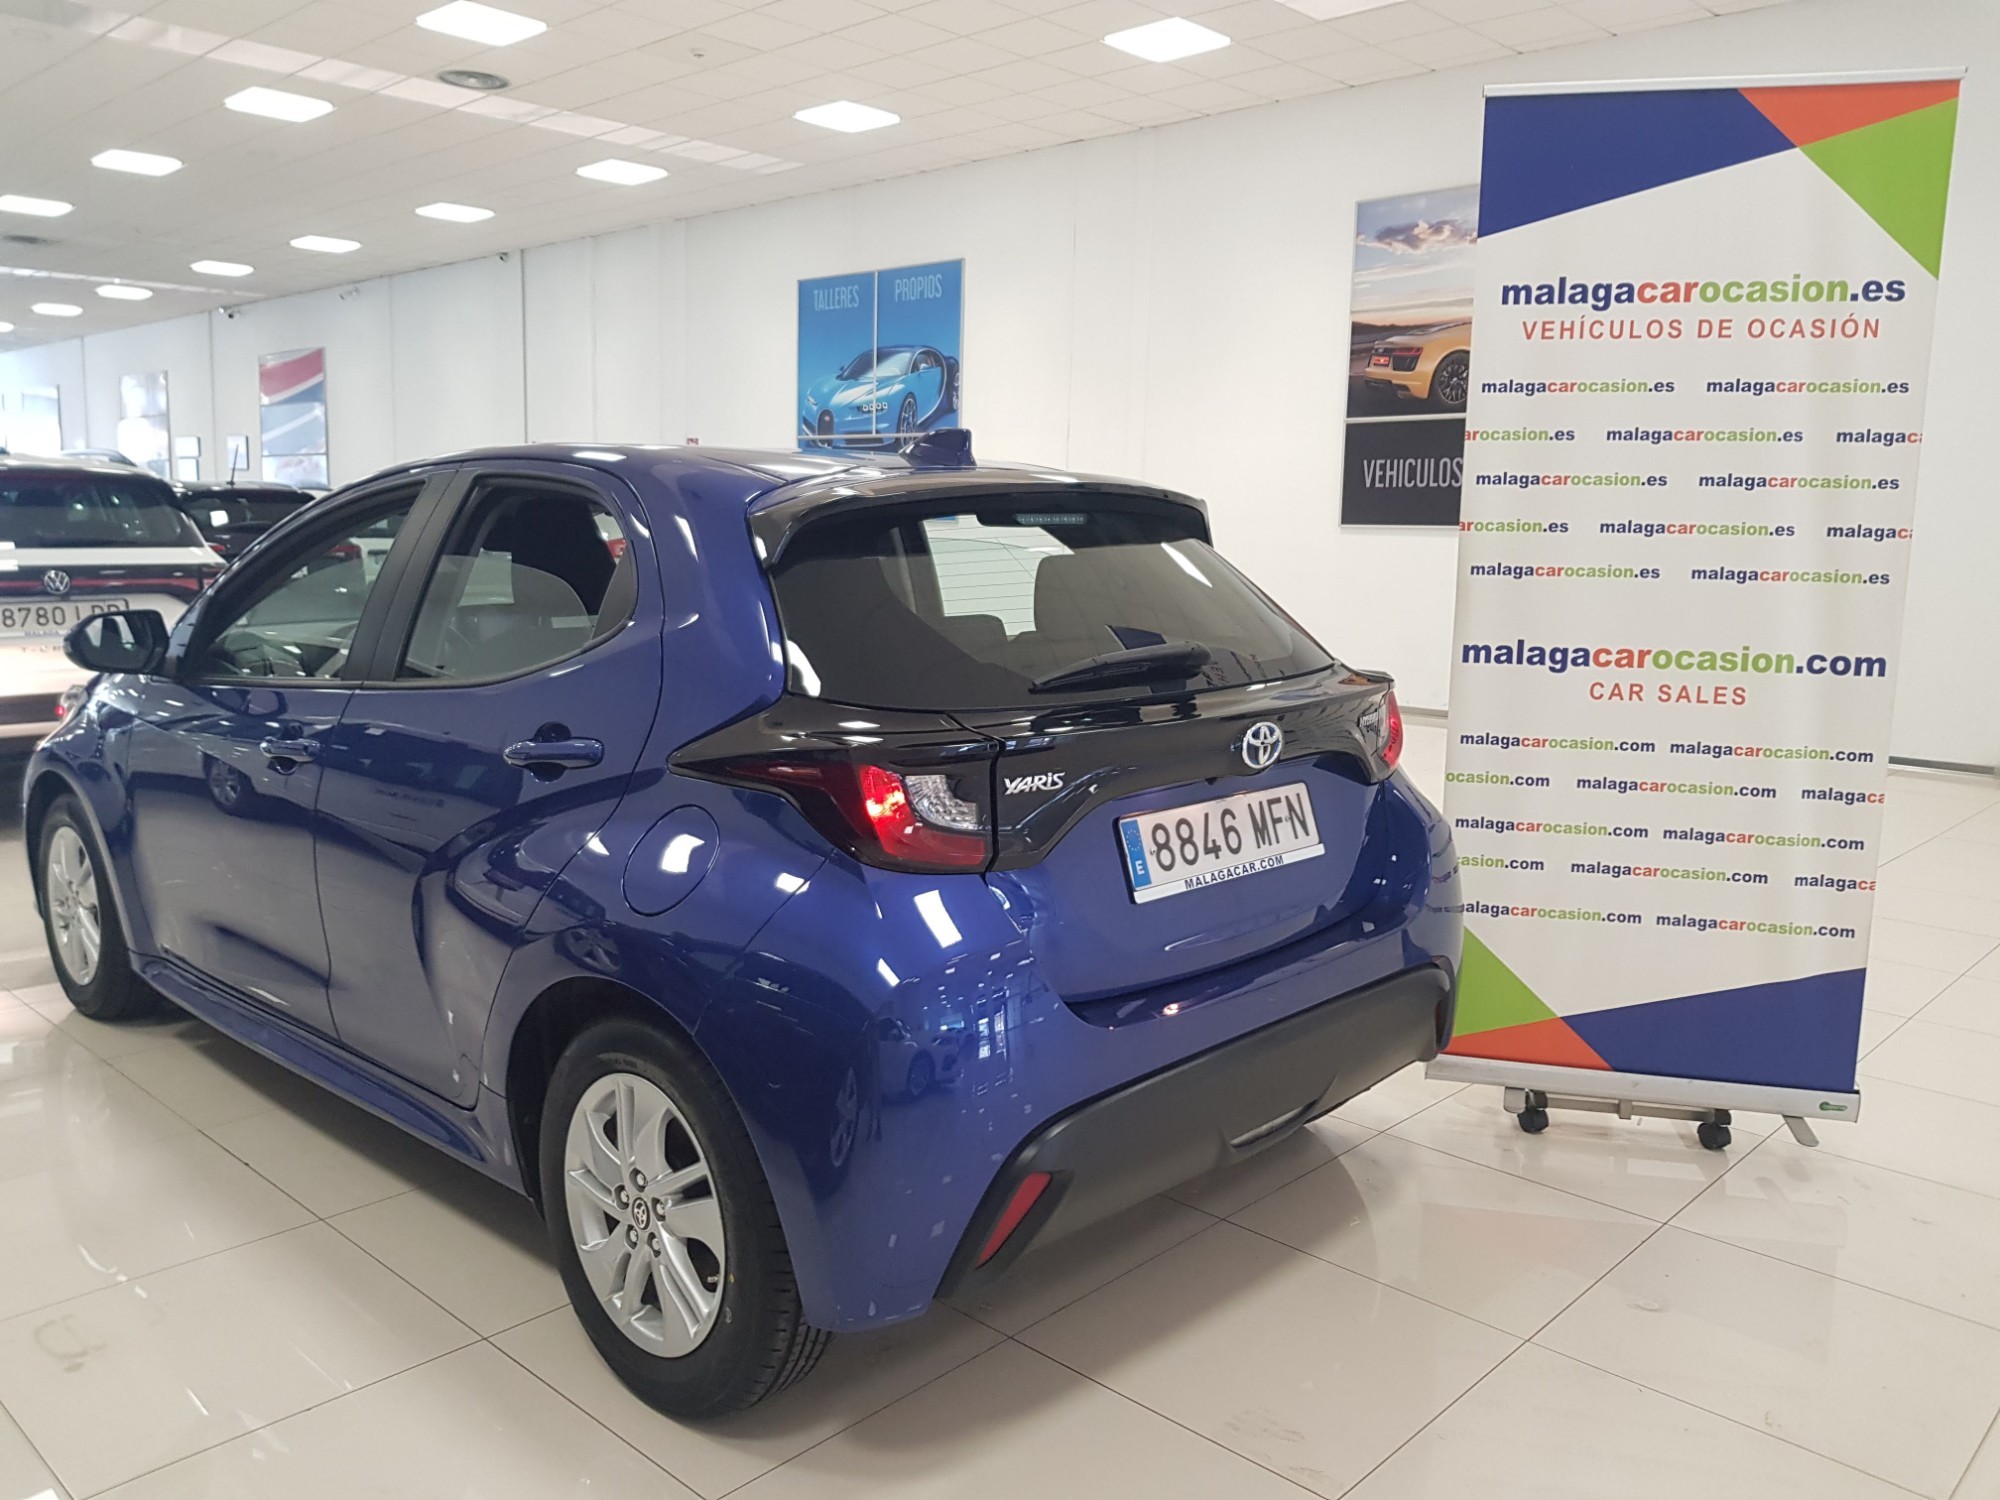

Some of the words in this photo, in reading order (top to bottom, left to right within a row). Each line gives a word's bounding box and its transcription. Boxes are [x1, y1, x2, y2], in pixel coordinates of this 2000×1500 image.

[813, 285, 860, 311] TALLERES
[894, 274, 942, 301] PROPIOS
[1501, 274, 1906, 312] malagacarocasion.es
[1522, 314, 1683, 340] VEHÍCULOS
[1697, 319, 1733, 339] DE
[1747, 312, 1880, 339] OCASIÓN
[1481, 379, 1675, 396] malagacarocasion.es
[1706, 378, 1910, 396] malagacarocasion.es
[1606, 427, 1803, 445] malagacarocasion.es
[1363, 457, 1464, 488] VEHICULOS
[1475, 472, 1667, 489] malagacarocasion.es
[1698, 473, 1900, 492] malagacarocasion.es
[1599, 520, 1795, 538] malagacarocasion.es
[1470, 562, 1660, 580] malagacarocasion.es
[1691, 566, 1890, 585] malagacarocasion.es
[2, 606, 66, 628] 8780
[1461, 639, 1886, 677] malagacarocasion.com
[1589, 682, 1643, 702] CAR
[1658, 685, 1746, 705] SALES
[1459, 731, 1655, 753] malagacarocasion.com
[1670, 741, 1873, 763] malagacarocasion.com
[1576, 776, 1776, 799] malagacarocasion.com
[1151, 808, 1242, 872] 8846
[1247, 792, 1310, 849] MFN
[1455, 816, 1648, 838] malagacarocasion.com
[1663, 827, 1864, 850] malagacarocasion.com
[1136, 860, 1145, 875] E
[1184, 855, 1284, 890] MALAGACAR.COM
[1570, 860, 1768, 885] malagacarocasion.com
[1656, 914, 1855, 939] malagacarocasion.com
